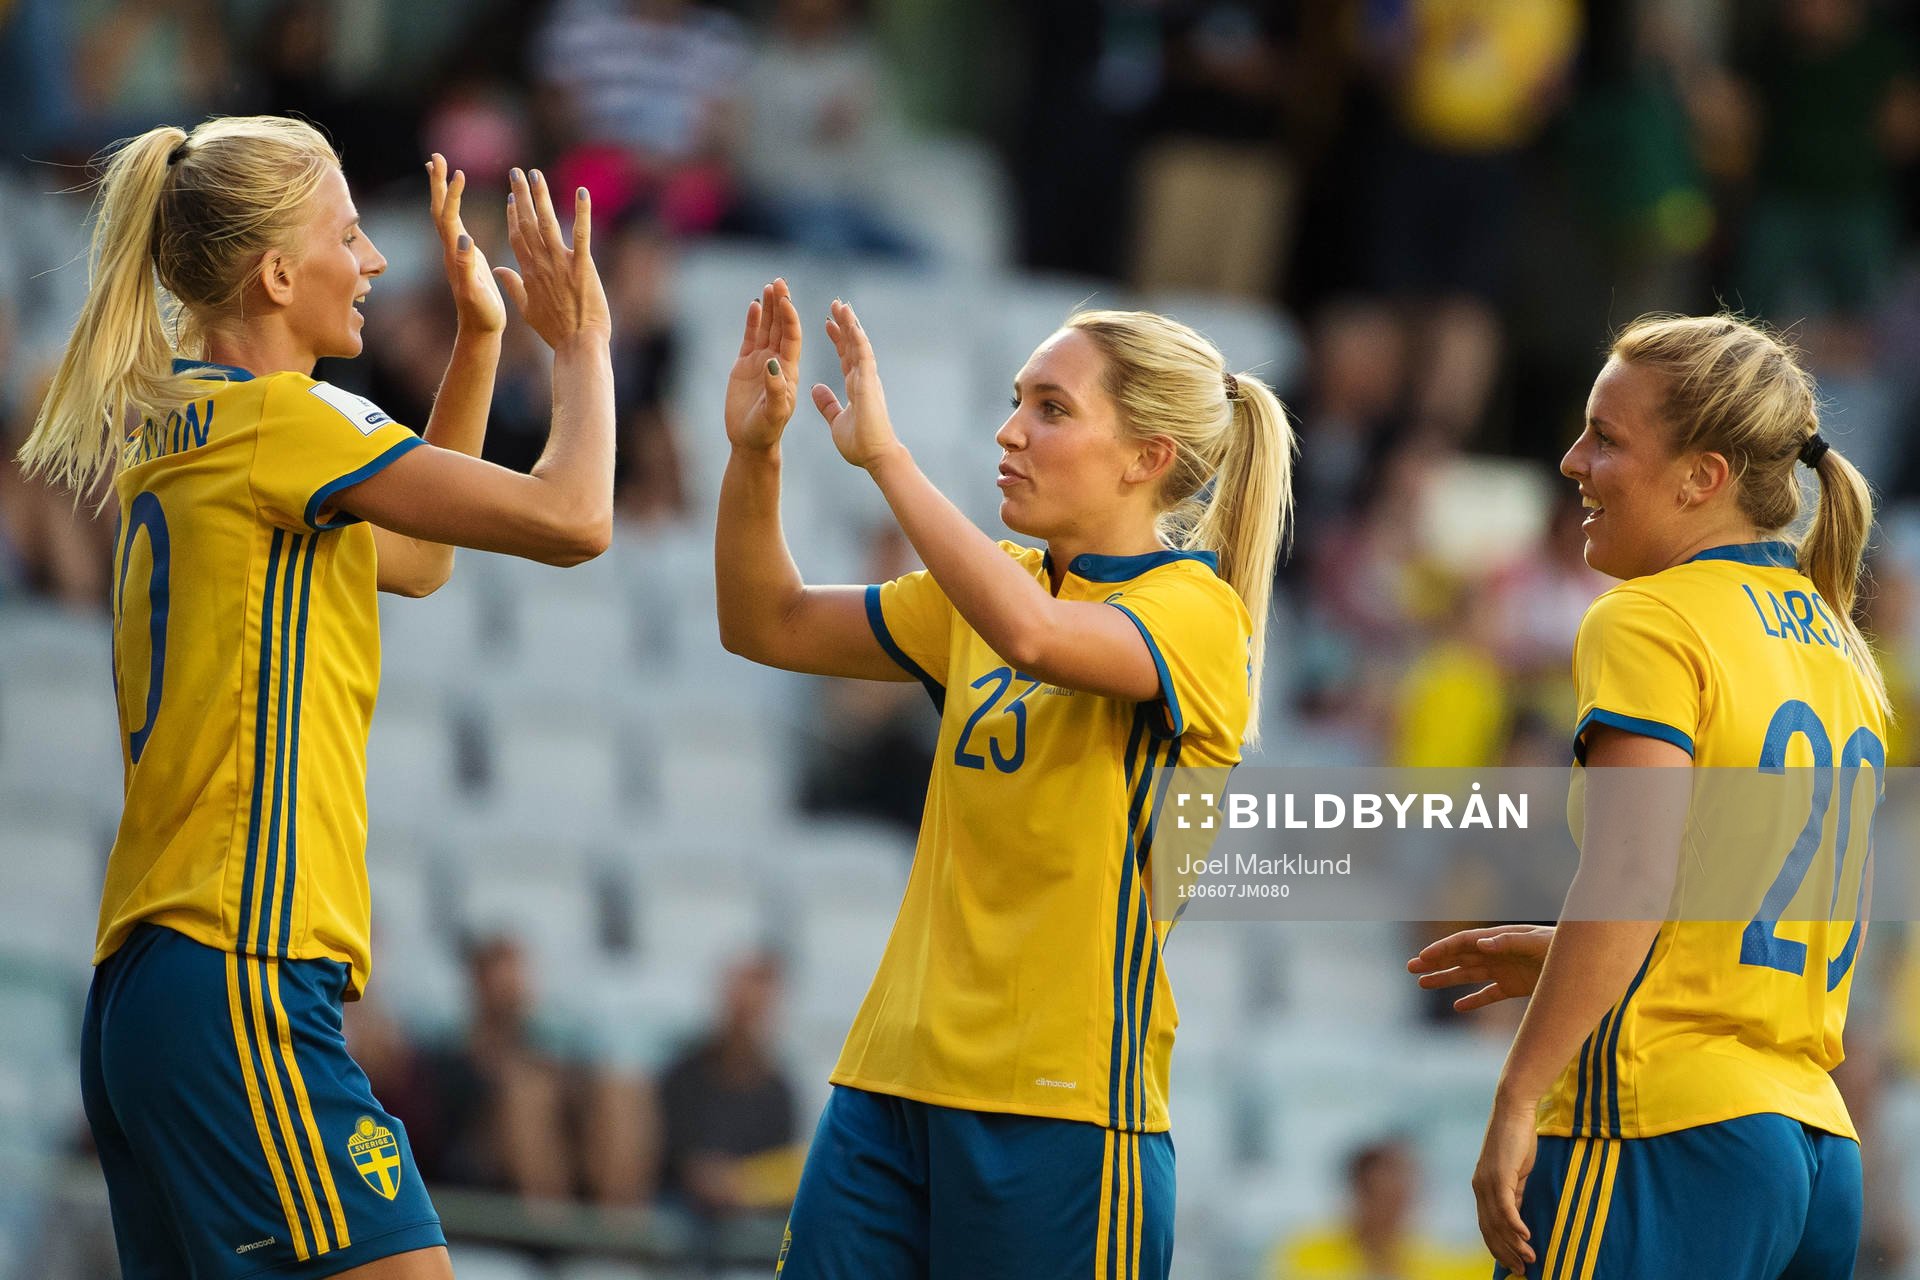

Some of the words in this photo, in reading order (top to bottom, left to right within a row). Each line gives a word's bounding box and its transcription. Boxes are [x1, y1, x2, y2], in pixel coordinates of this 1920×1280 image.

[1741, 584, 1848, 656] LARS
[955, 666, 1041, 774] 23
[1740, 700, 1885, 993] 20
[354, 1137, 389, 1152] SVERIGE
[236, 1236, 275, 1254] climacool
